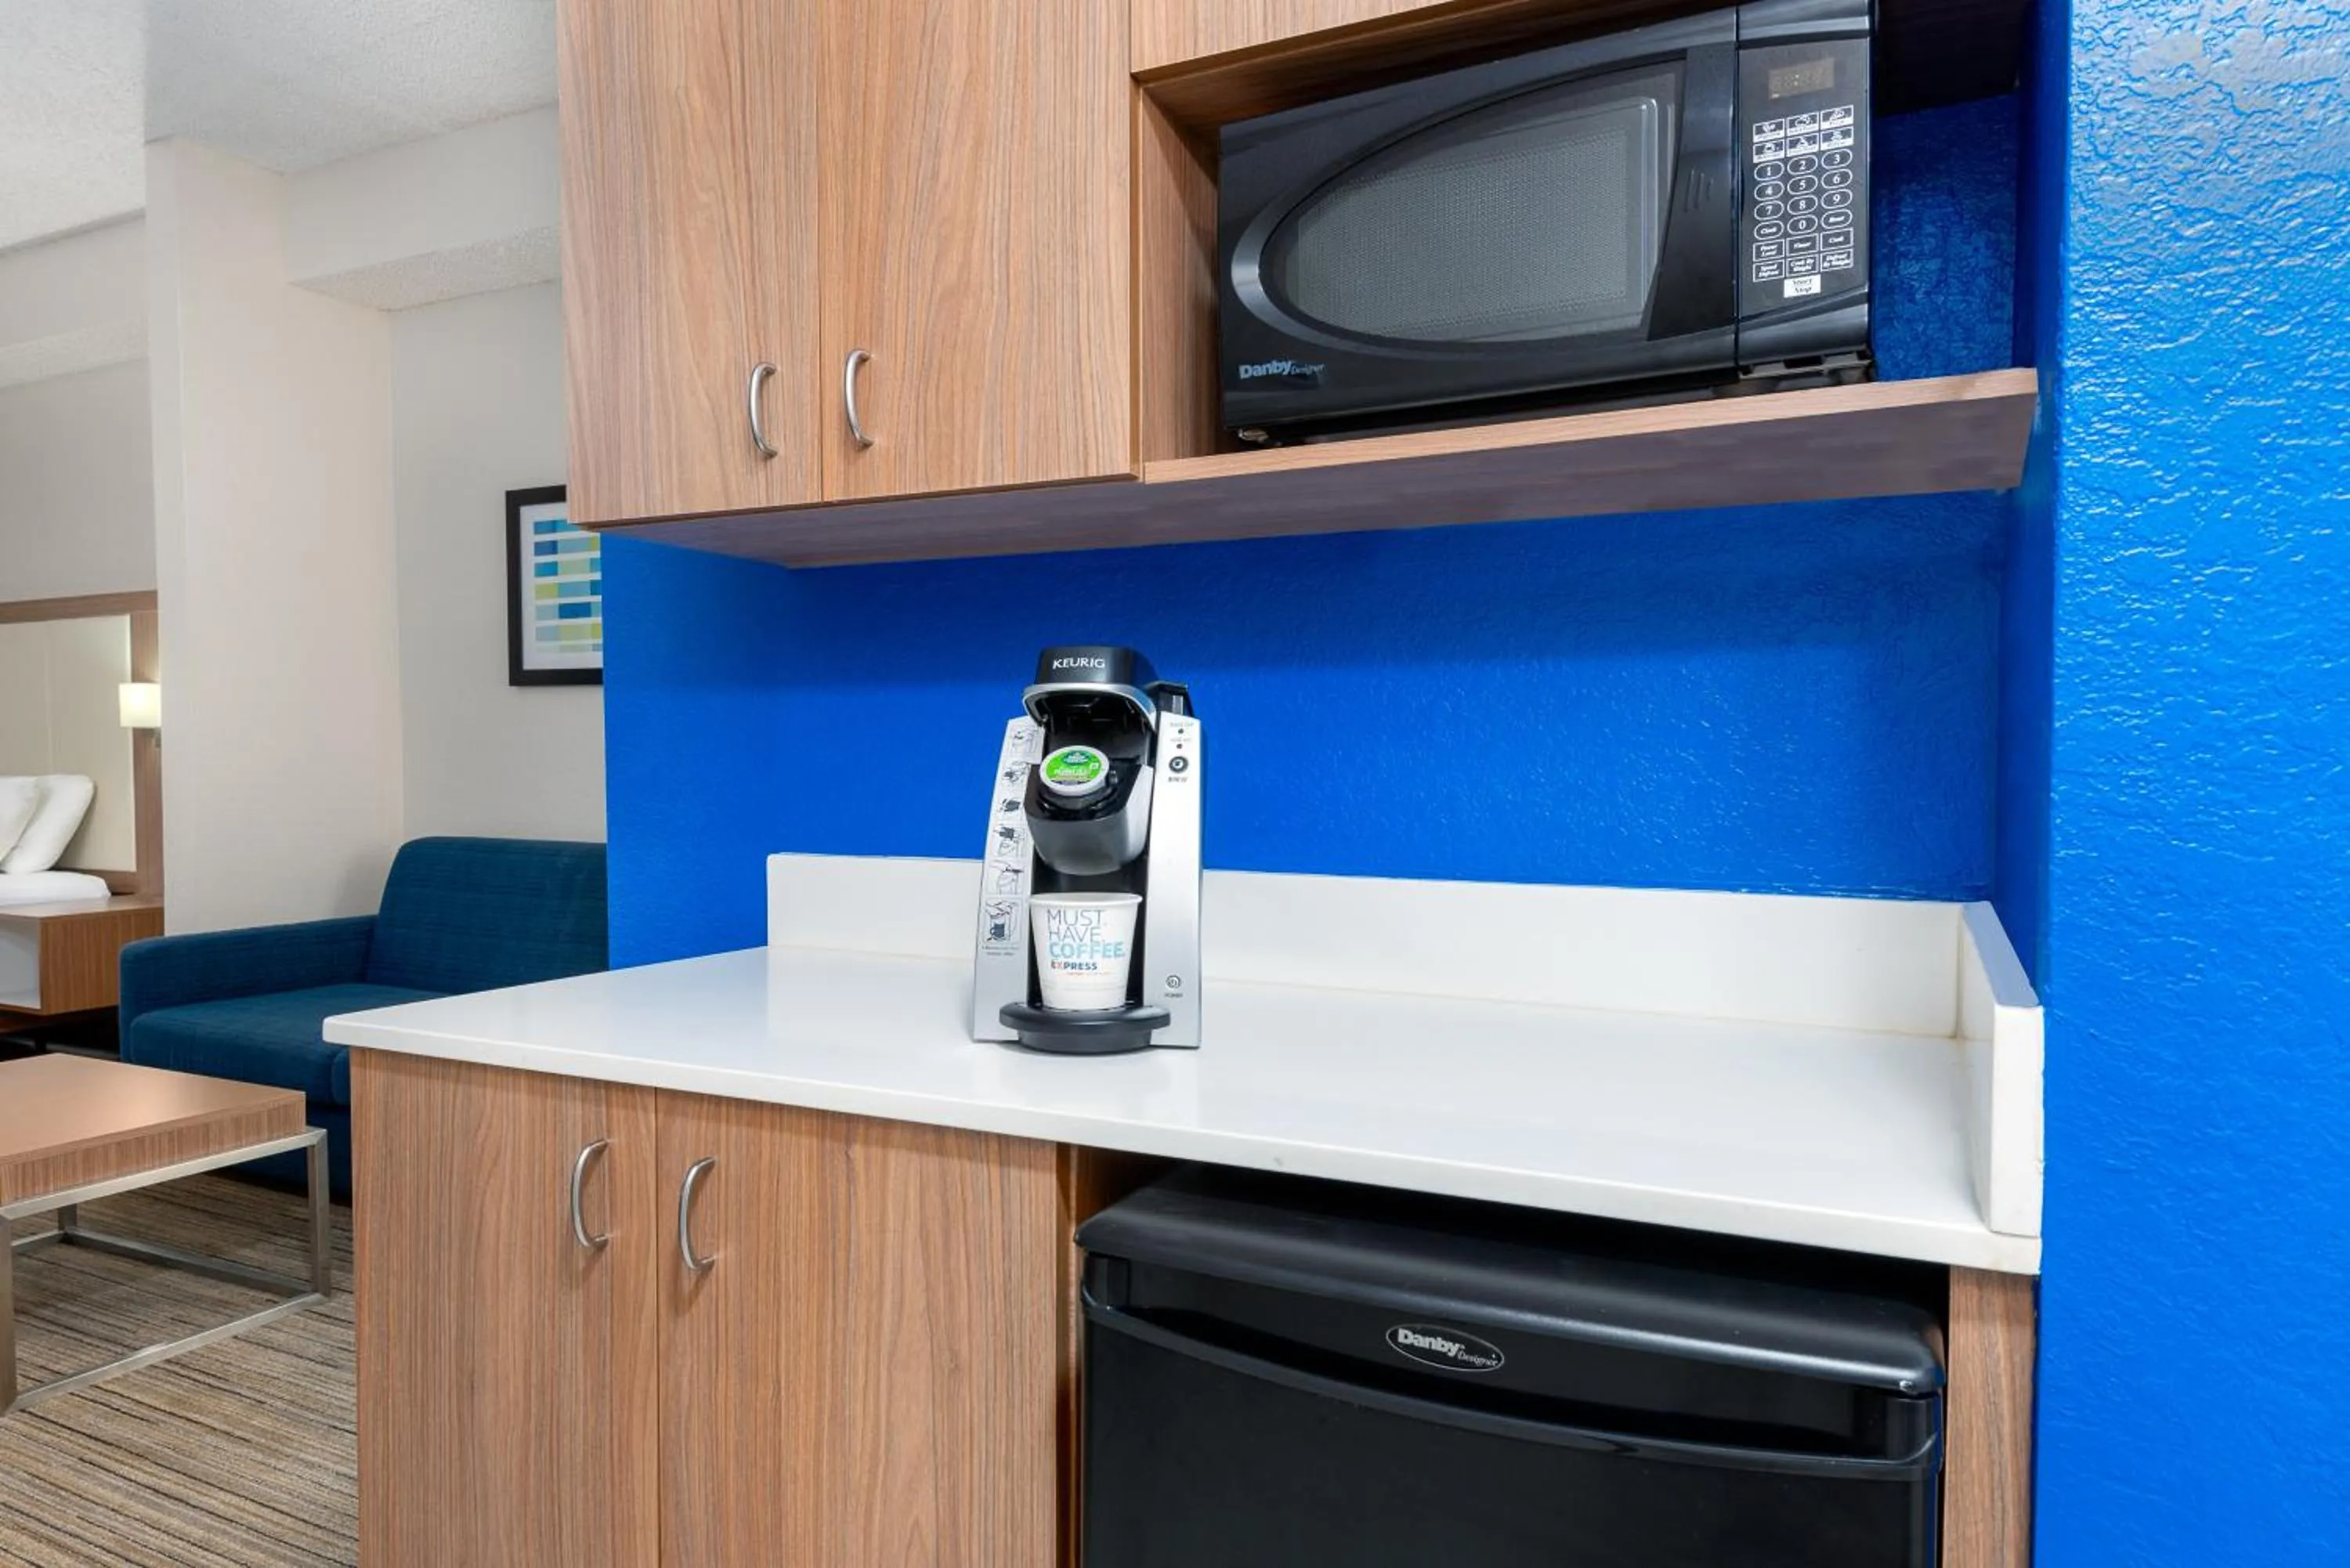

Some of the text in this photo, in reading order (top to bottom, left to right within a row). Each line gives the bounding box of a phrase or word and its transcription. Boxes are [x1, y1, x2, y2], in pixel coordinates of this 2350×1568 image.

[1833, 154, 1840, 164] 3
[1799, 161, 1806, 170] 2
[1833, 174, 1840, 184] 6
[1799, 180, 1806, 190] 5
[1765, 186, 1773, 195] 4
[1833, 193, 1840, 204] 9
[1765, 205, 1773, 215] 7
[1799, 200, 1806, 210] 8
[1799, 220, 1806, 229] 0
[1238, 359, 1292, 380] Danby
[1052, 657, 1105, 670] KEURIG
[1050, 960, 1098, 970] EXPRESS
